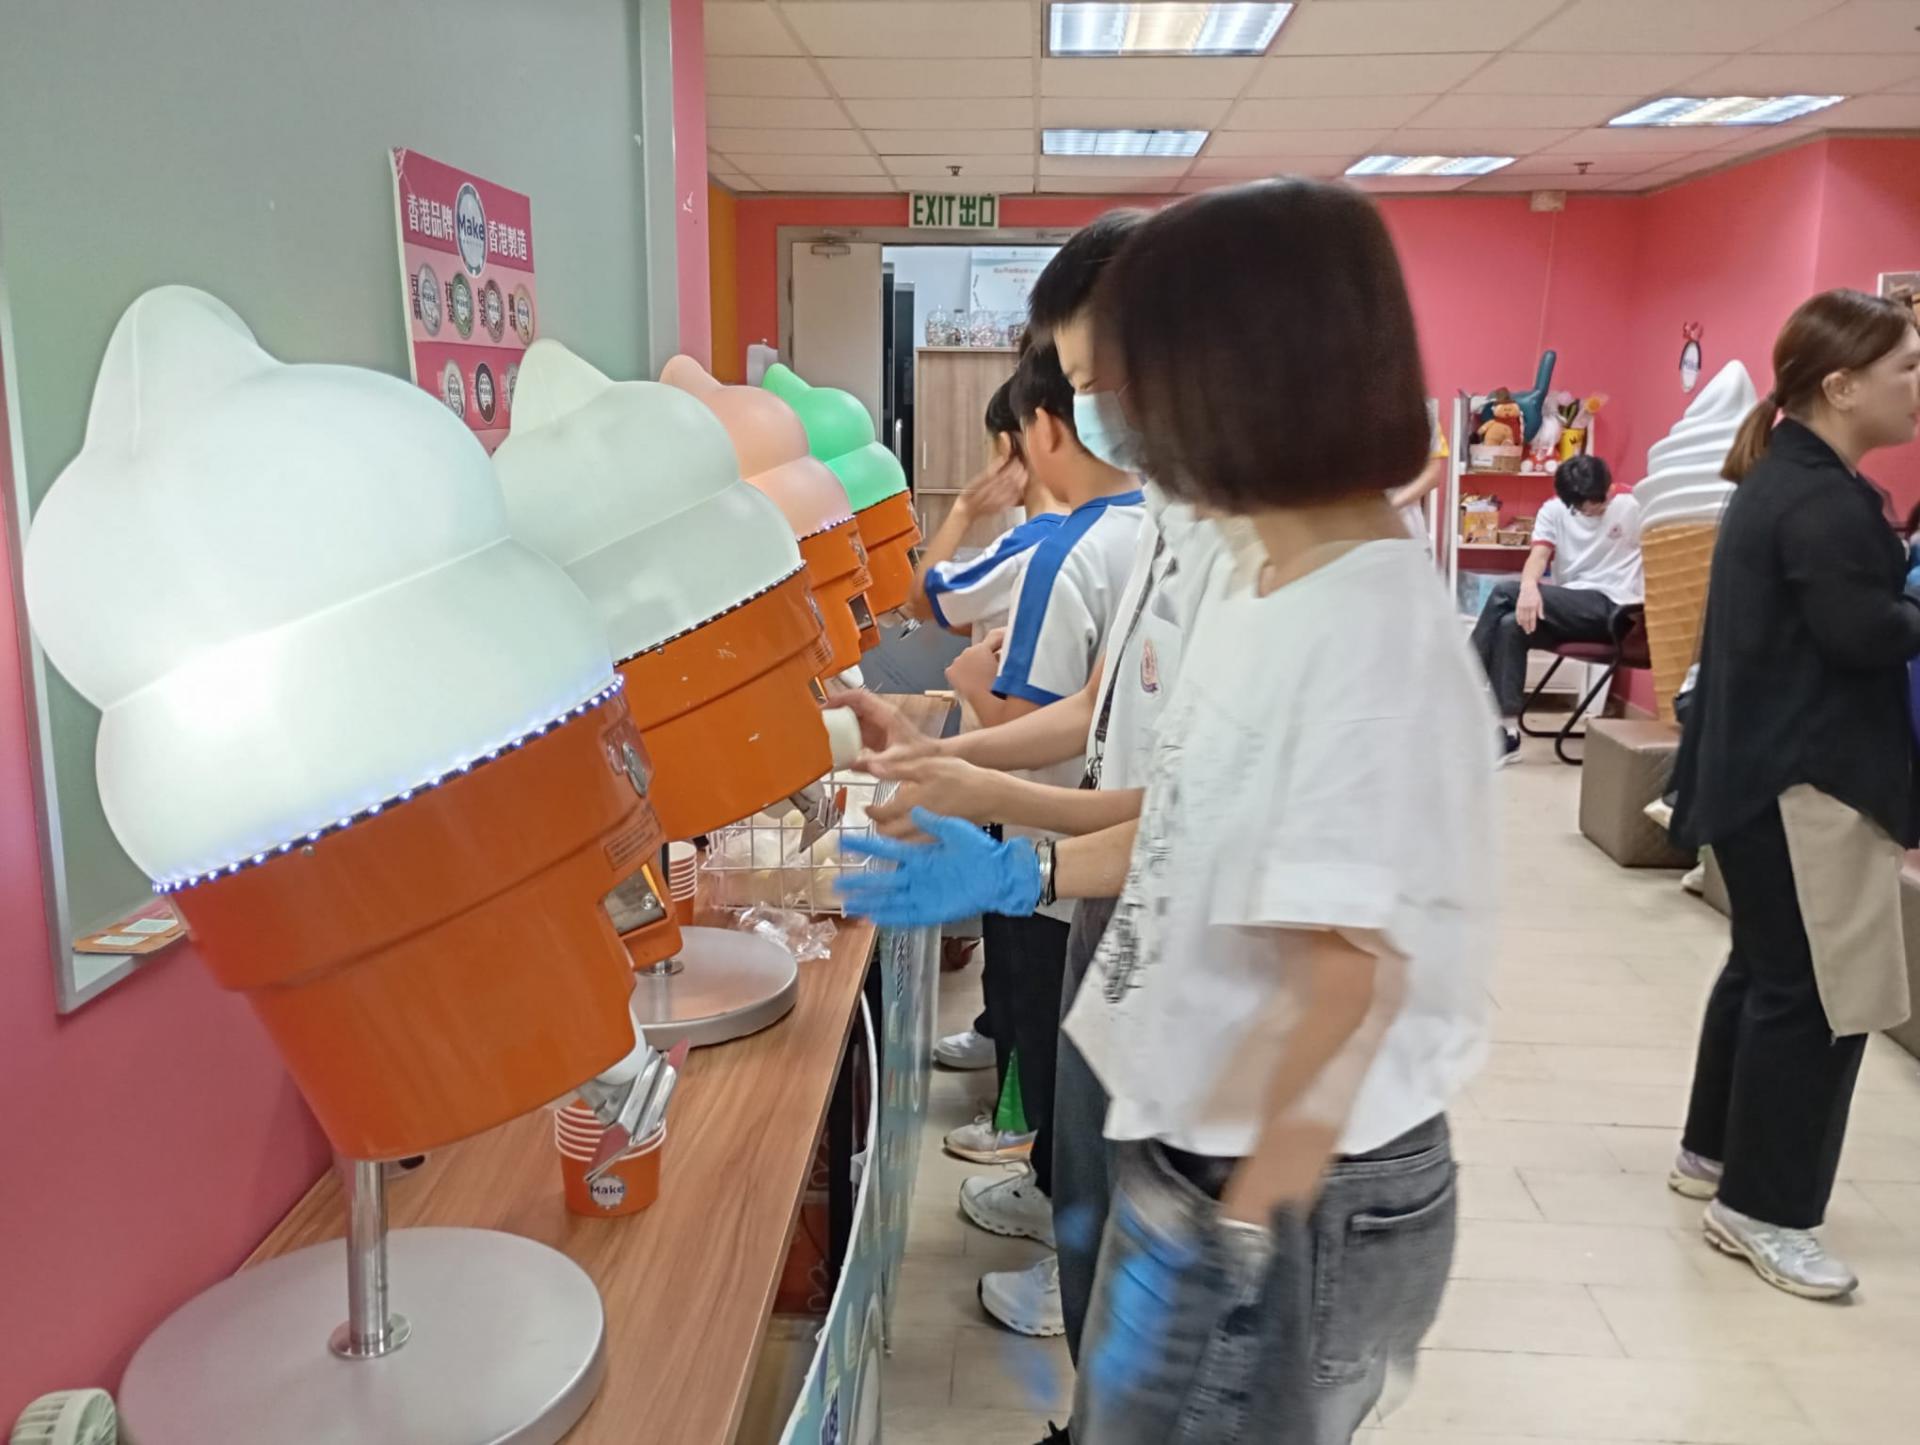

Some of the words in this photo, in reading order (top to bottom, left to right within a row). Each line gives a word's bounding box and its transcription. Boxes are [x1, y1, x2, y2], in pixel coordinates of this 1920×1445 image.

[407, 193, 454, 241] 香港品牌
[457, 213, 485, 241] Make
[913, 195, 955, 226] EXIT
[959, 194, 995, 227] 出口
[488, 220, 528, 261] 香港製造
[590, 1184, 625, 1195] Make
